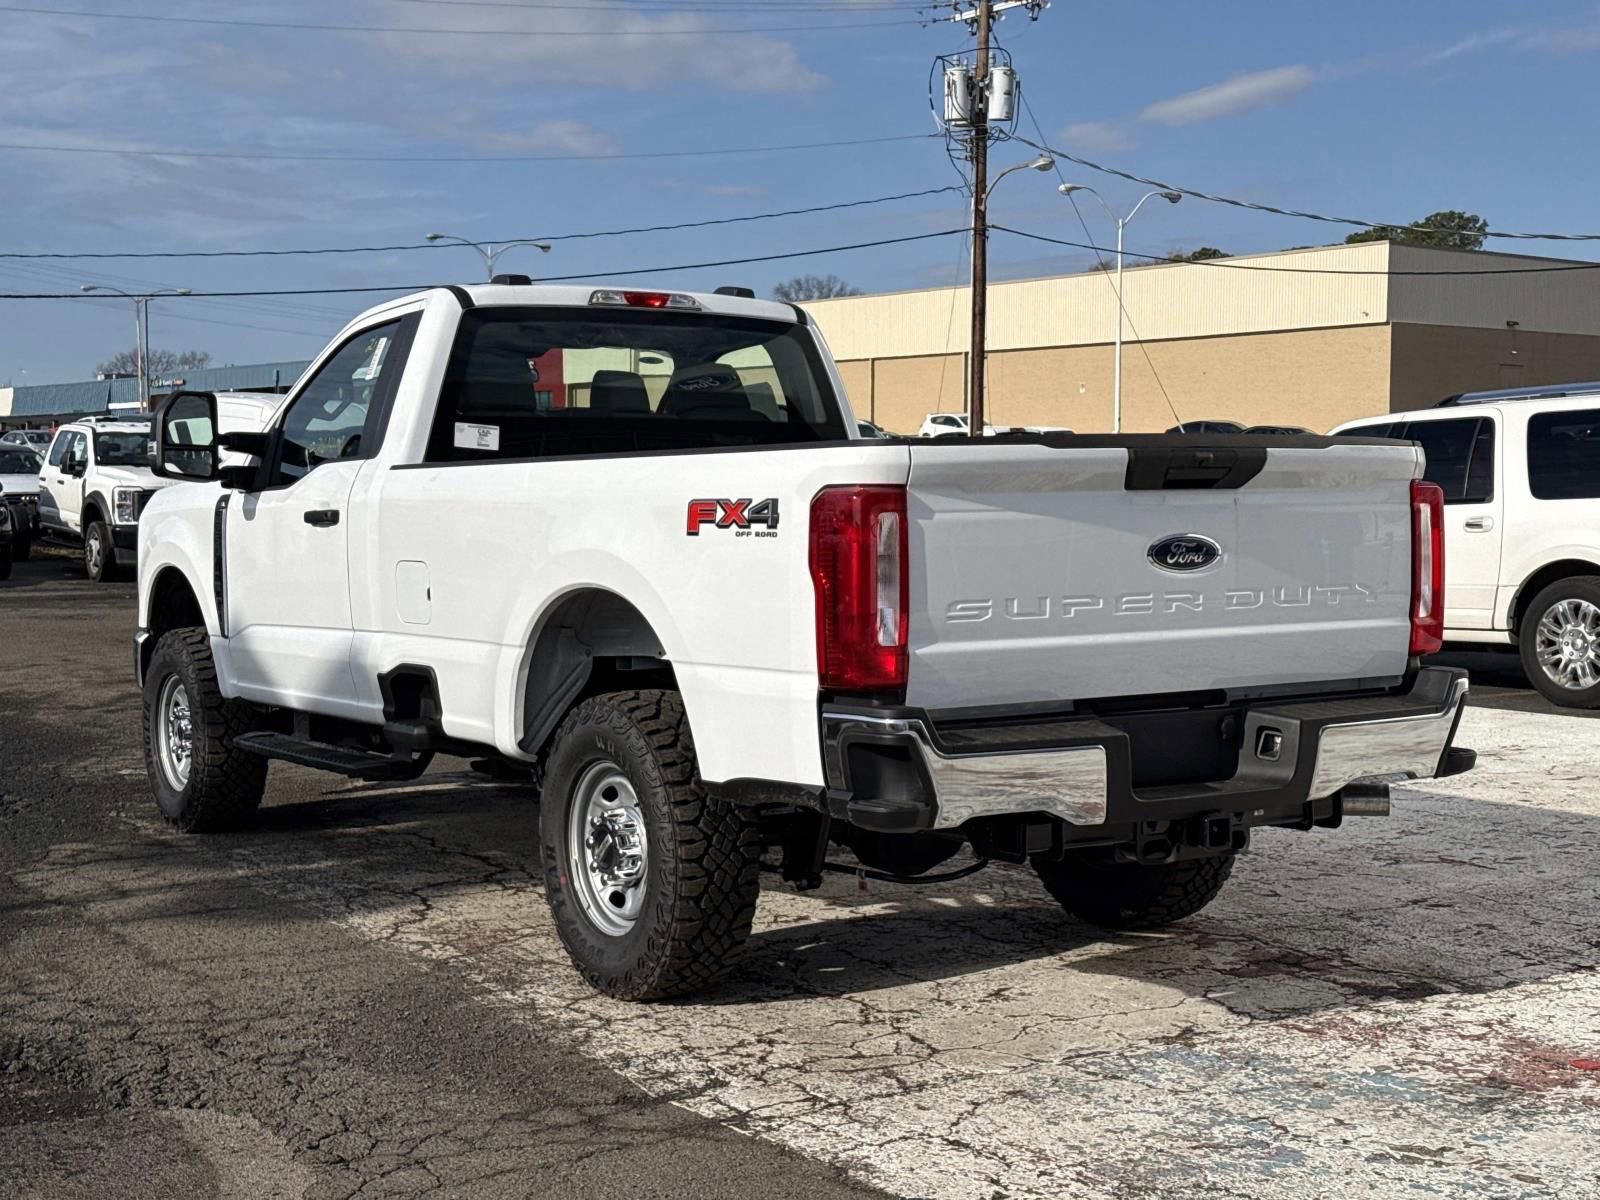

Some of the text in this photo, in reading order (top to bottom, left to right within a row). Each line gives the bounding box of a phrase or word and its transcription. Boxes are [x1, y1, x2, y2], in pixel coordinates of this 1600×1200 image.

[686, 497, 780, 536] FX4
[754, 530, 778, 538] ROAD
[1166, 541, 1207, 564] Ford
[944, 583, 1384, 623] SUPER DUTY
